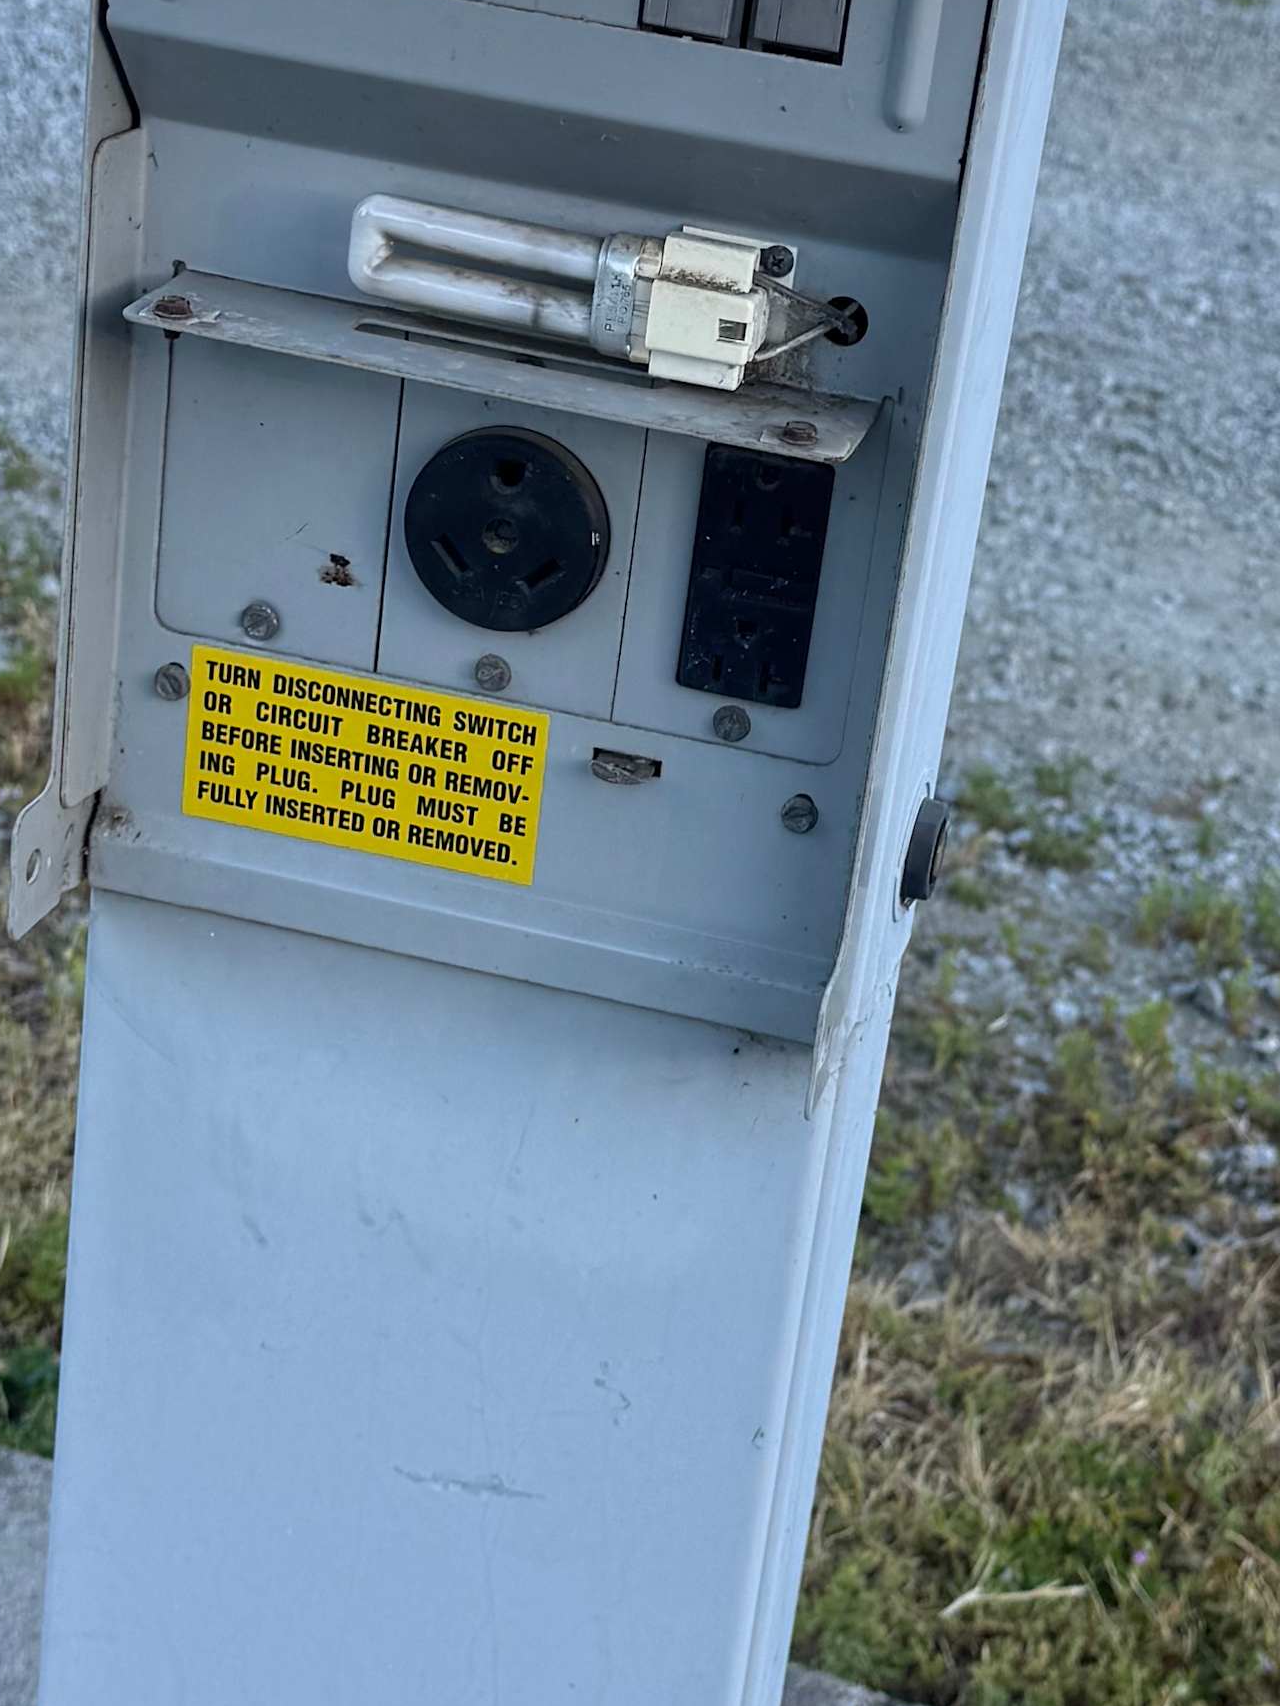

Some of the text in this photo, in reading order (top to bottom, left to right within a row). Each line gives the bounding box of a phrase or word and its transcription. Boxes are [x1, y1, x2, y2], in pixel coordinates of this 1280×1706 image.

[204, 691, 534, 775] OR CIRCUIT BREAKER OFF
[206, 660, 537, 746] TURN DISCONNECTING SWITCH
[199, 750, 527, 837] ING PLUG. PLUG MUST BE
[201, 720, 530, 805] BEFORE INSERTING OR REMOV-
[197, 780, 518, 866] FULLY INSERTED OR REMOVED.
